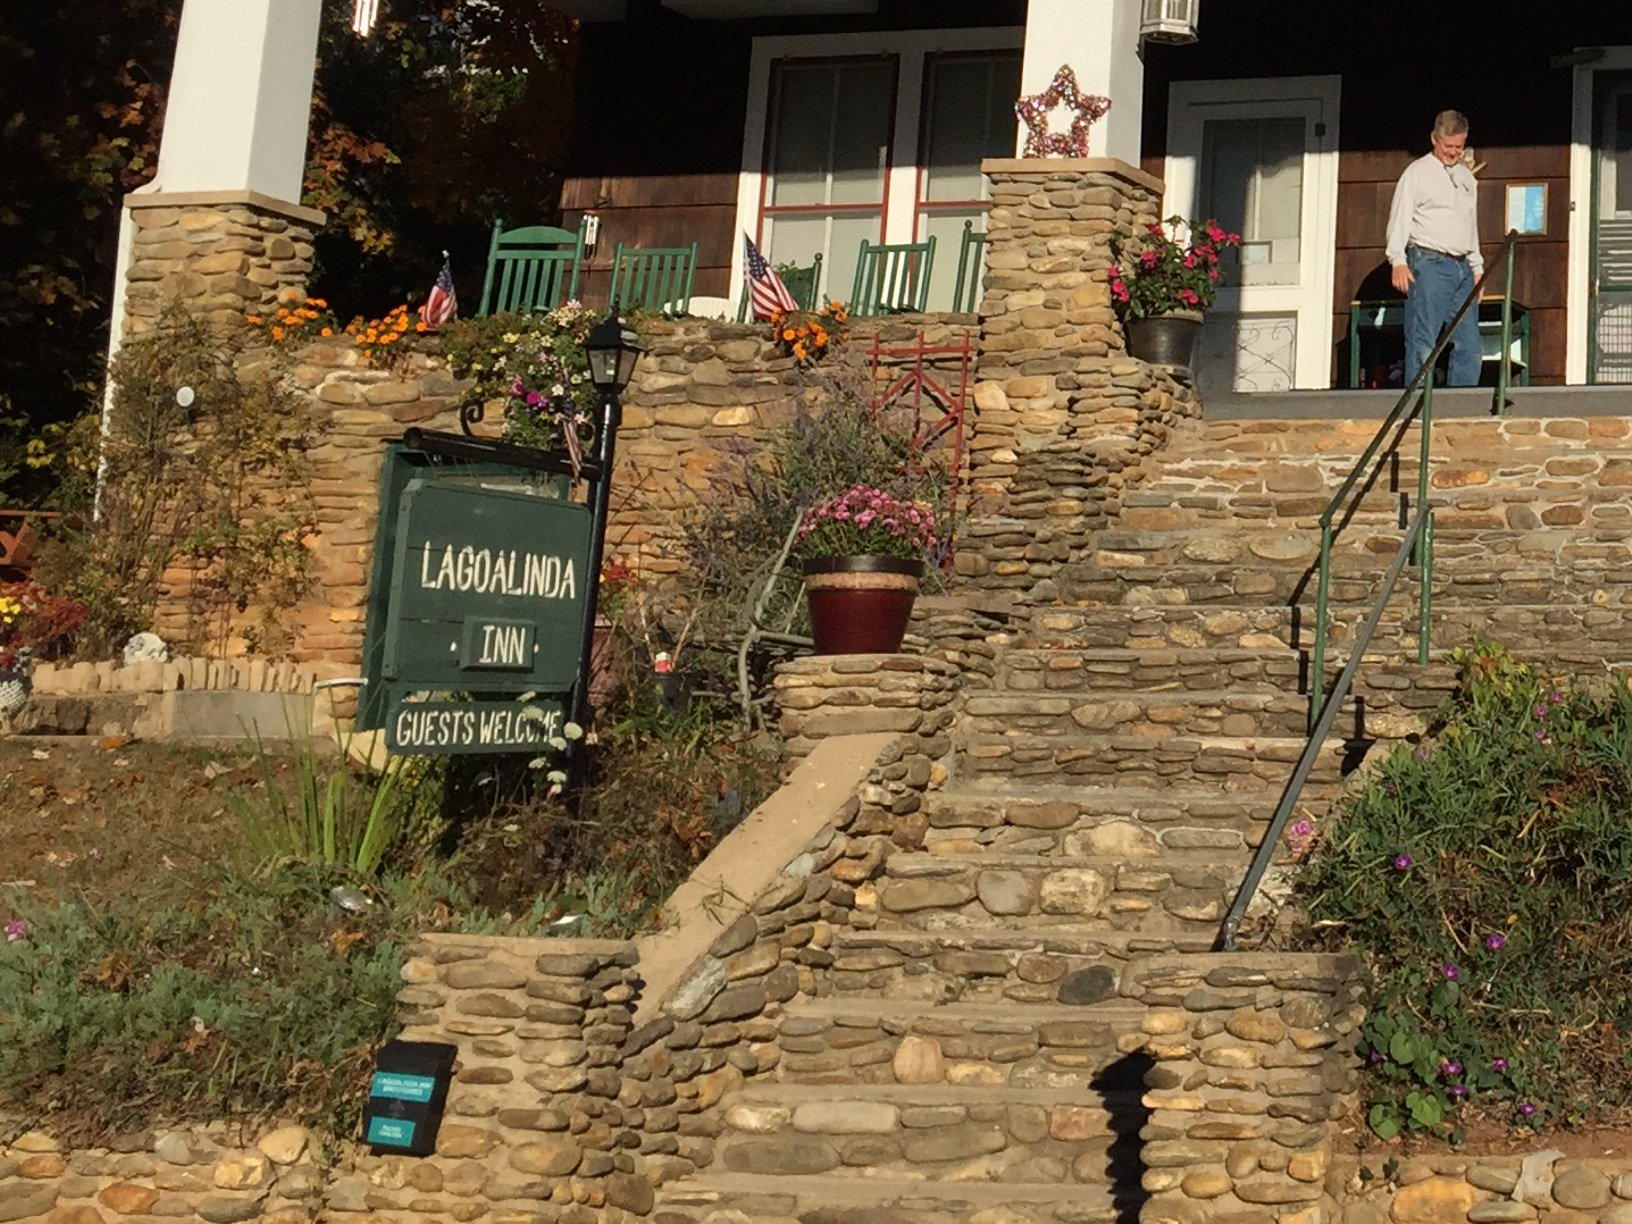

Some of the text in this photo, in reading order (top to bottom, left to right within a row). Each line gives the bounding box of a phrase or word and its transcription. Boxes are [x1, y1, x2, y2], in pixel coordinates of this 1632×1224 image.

[421, 540, 575, 599] LAGOALINDA
[479, 625, 525, 664] INN
[396, 710, 475, 746] GUESTS
